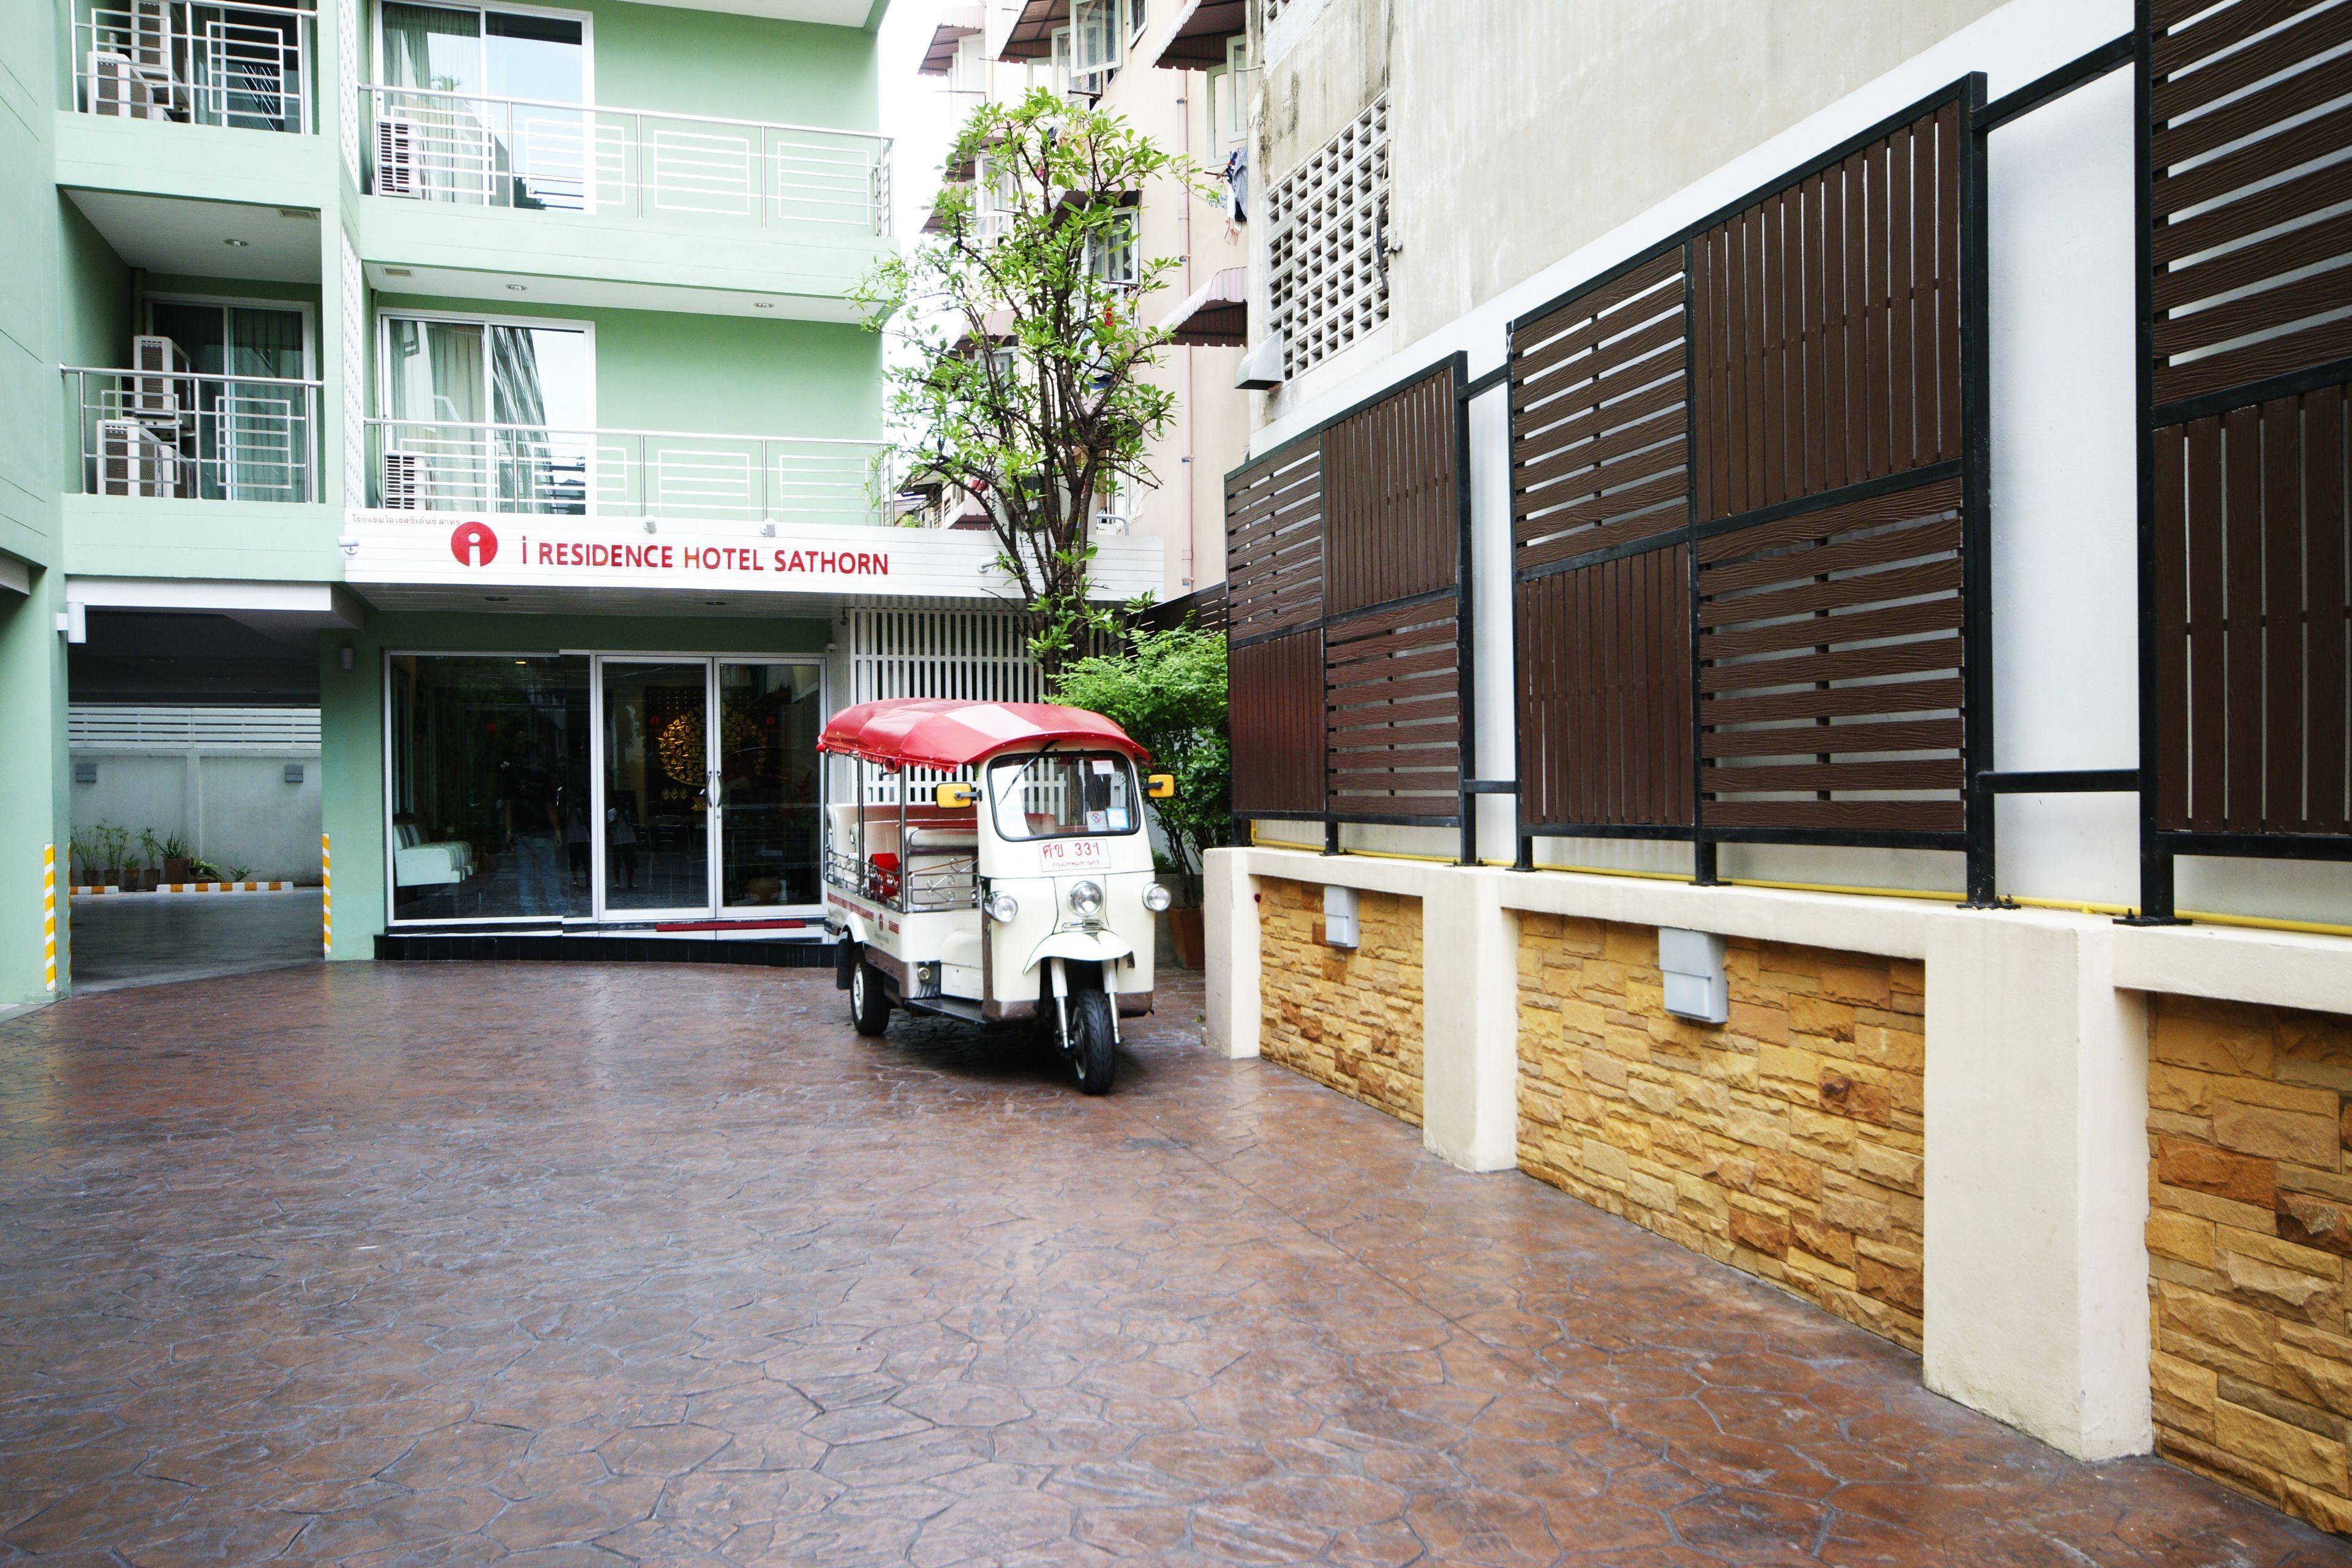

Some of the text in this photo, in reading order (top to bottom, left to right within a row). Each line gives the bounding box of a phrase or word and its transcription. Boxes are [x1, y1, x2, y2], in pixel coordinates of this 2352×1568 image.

[539, 542, 673, 568] RESIDENCE
[684, 546, 764, 571] HOTEL
[774, 549, 888, 575] SATHORN
[1074, 842, 1100, 856] 331
